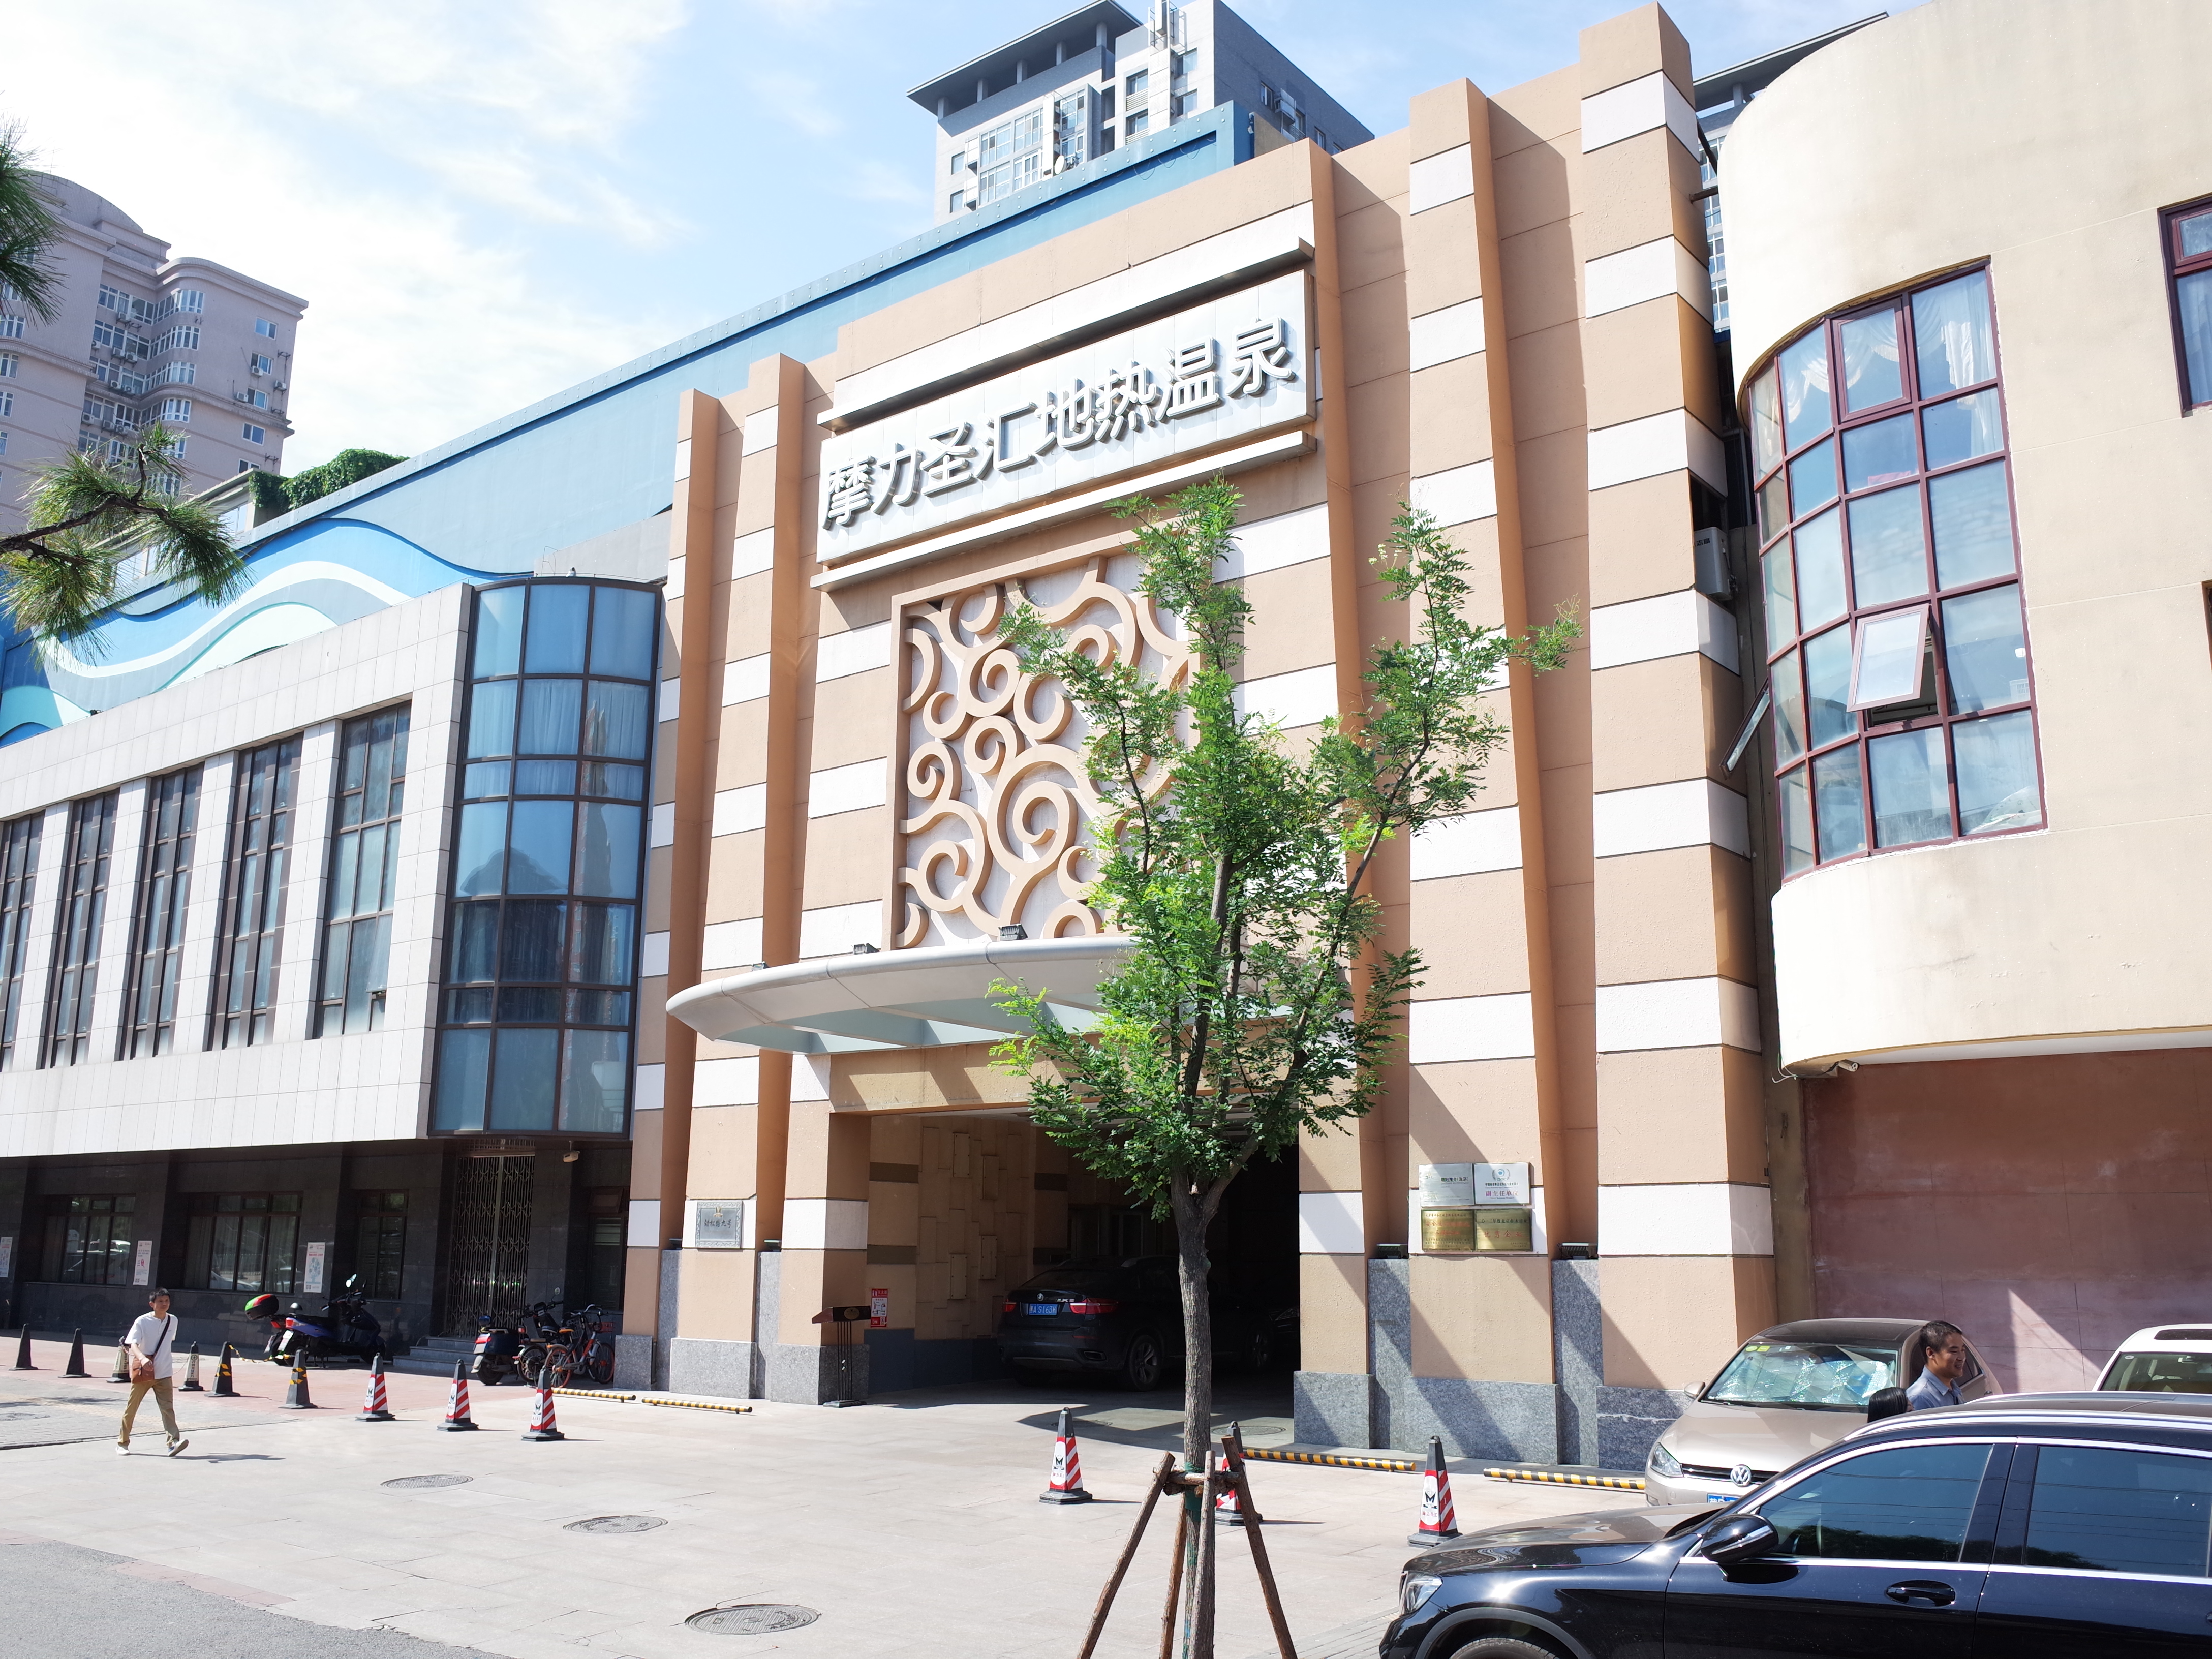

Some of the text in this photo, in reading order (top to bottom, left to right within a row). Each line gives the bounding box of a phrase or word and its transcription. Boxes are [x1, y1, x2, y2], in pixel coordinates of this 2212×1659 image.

[821, 315, 1296, 530] 摩力圣汇地热温泉
